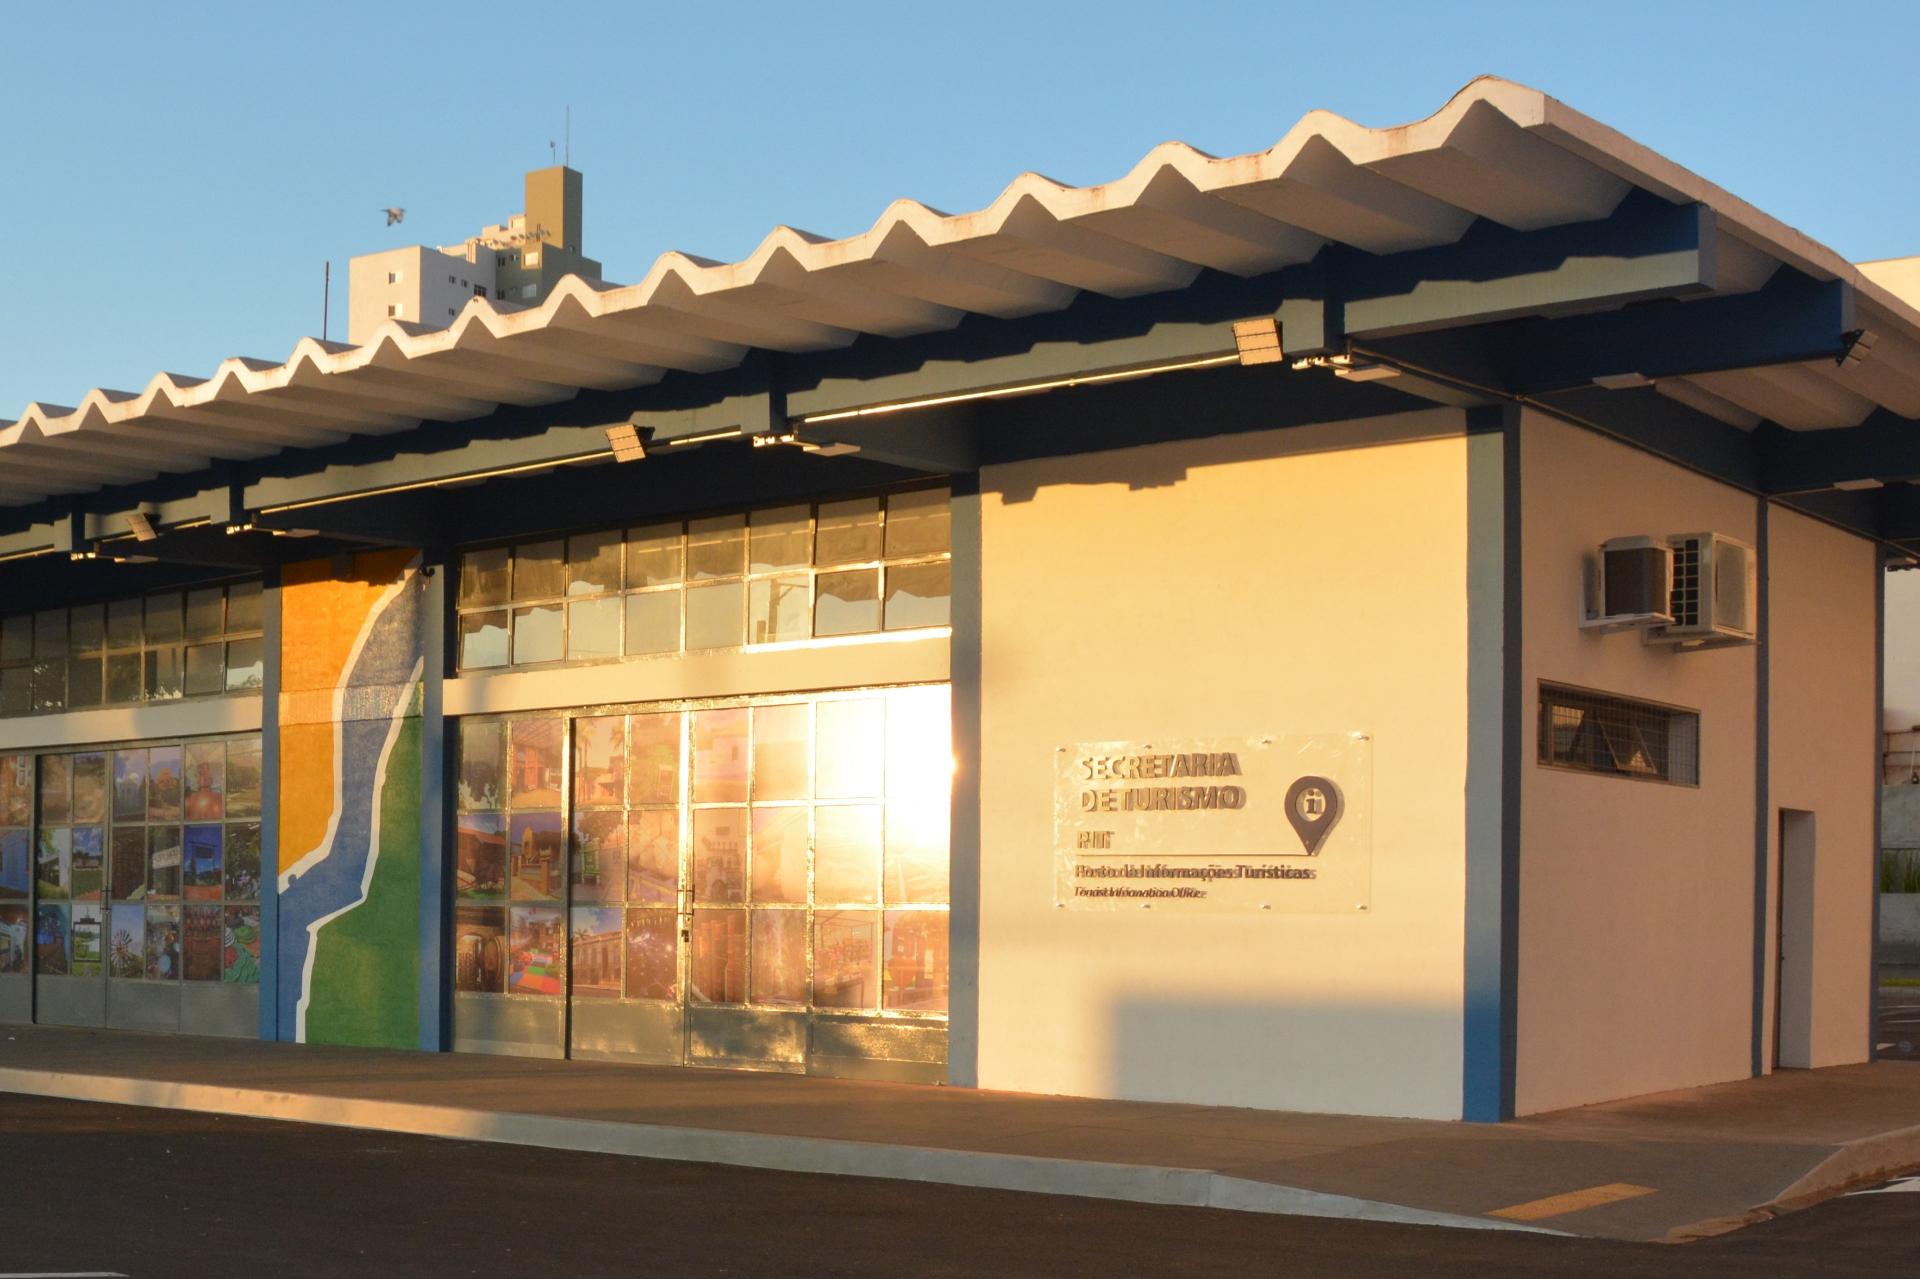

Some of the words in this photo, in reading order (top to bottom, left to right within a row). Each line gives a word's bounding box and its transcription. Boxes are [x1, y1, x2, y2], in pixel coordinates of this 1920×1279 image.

[1081, 752, 1240, 779] SECRETARIA
[1081, 787, 1116, 812] DE
[1117, 785, 1246, 812] TURISMO
[1141, 863, 1235, 882] Informações
[1235, 864, 1316, 880] Turísticas
